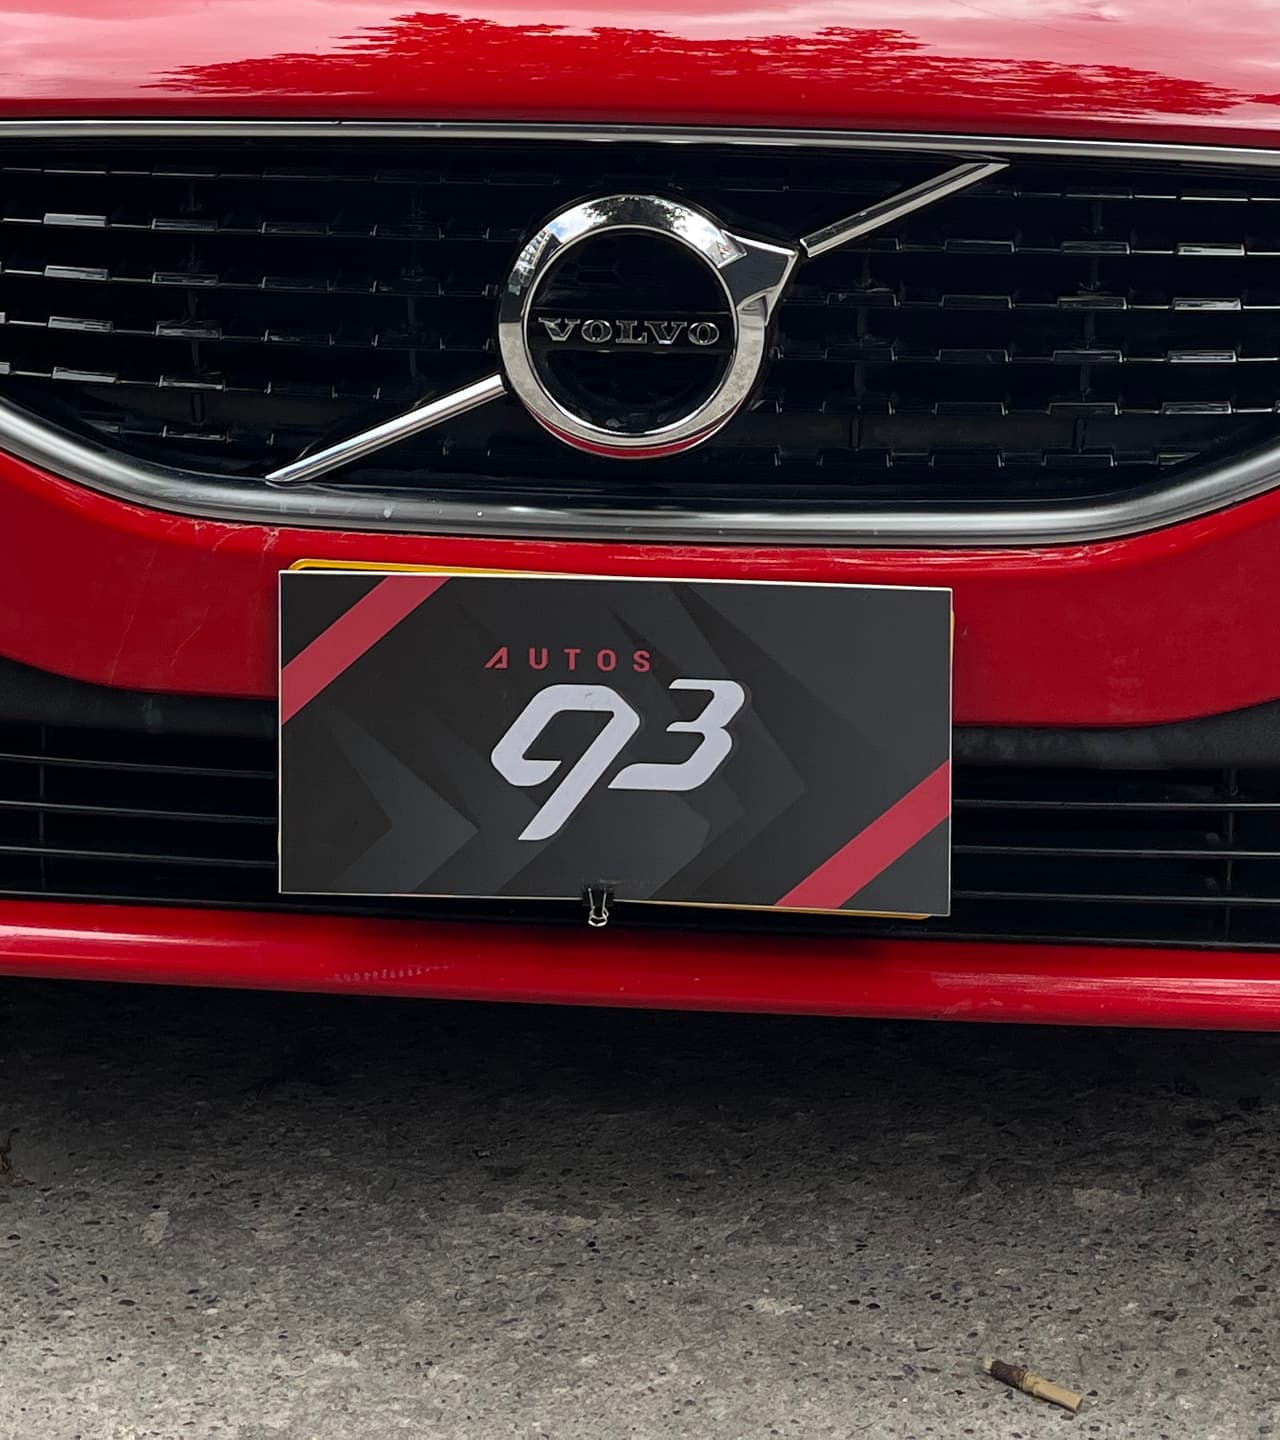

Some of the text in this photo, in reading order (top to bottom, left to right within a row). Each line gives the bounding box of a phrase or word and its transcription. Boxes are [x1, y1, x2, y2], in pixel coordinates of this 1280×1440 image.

[538, 316, 720, 346] VOLVO
[484, 646, 651, 672] AUTOS
[491, 678, 746, 841] 93
